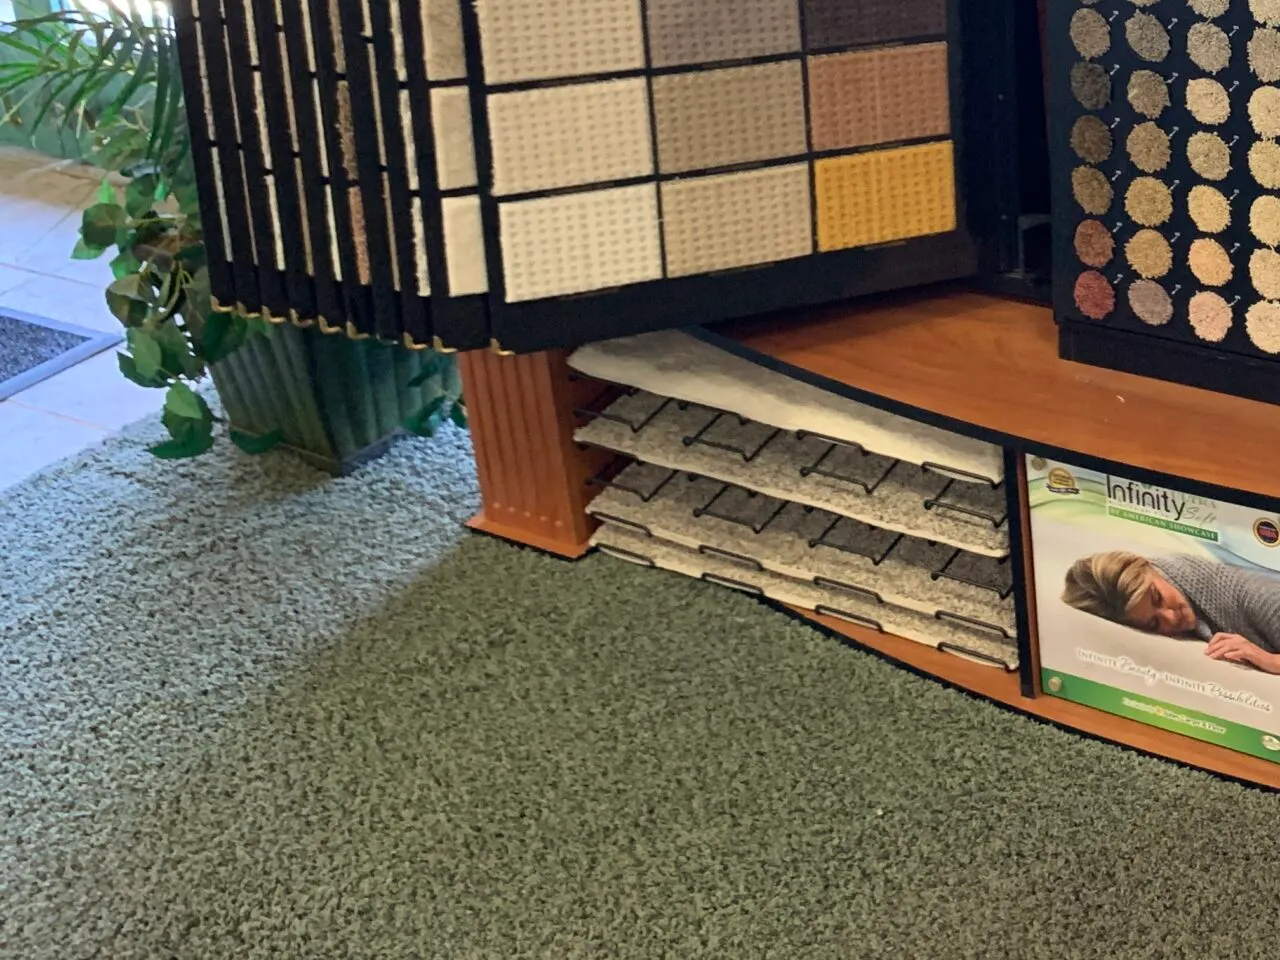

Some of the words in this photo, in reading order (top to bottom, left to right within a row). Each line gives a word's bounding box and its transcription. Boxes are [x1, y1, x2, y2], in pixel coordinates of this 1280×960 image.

[1106, 474, 1185, 521] Infinity
[1169, 522, 1216, 540] SHOWCASE
[1077, 648, 1118, 667] INFINITE
[1164, 674, 1207, 692] INFINITE
